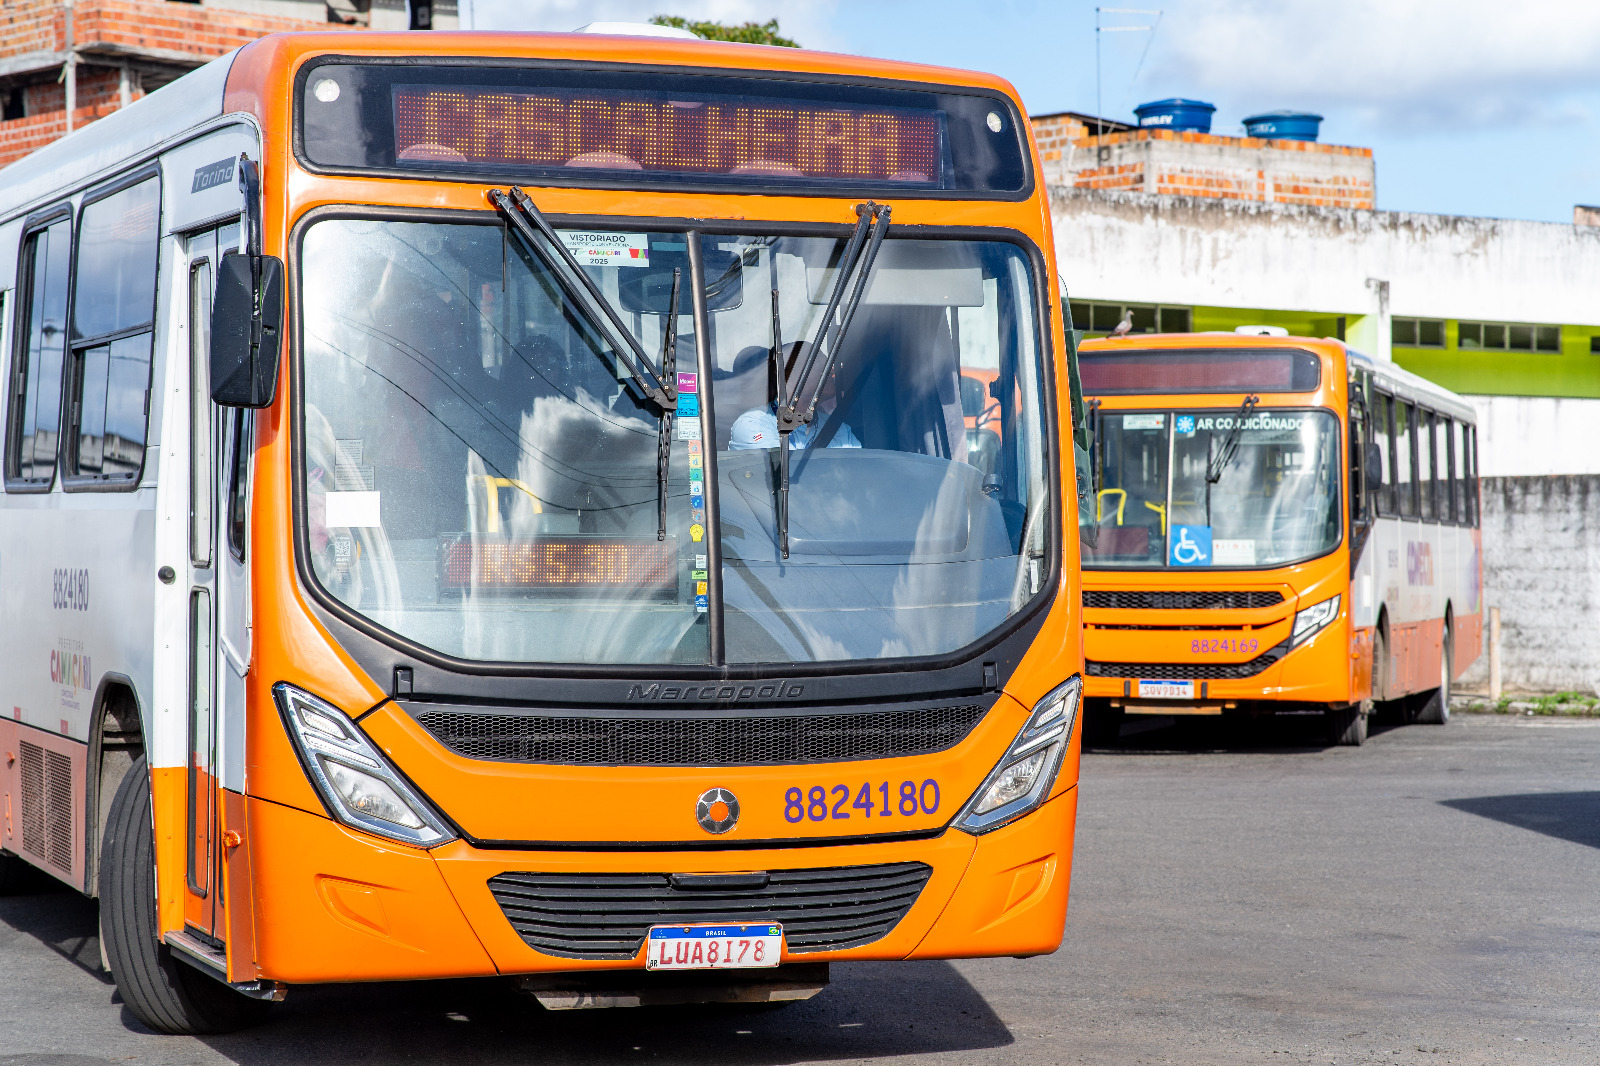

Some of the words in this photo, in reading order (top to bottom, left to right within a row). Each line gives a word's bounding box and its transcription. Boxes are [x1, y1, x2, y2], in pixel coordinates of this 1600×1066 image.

[425, 92, 898, 175] CASCALHEIRA
[195, 165, 234, 190] Torino
[569, 234, 626, 243] VISTORIADO
[1197, 418, 1214, 430] AR
[53, 568, 89, 611] 8824180
[1191, 638, 1259, 653] 8824169
[50, 649, 92, 696] CAMAÇARI
[627, 680, 805, 702] Marcopolo
[784, 778, 941, 824] 8824180
[705, 929, 727, 937] BRASIL
[659, 939, 765, 965] LUA8I78
